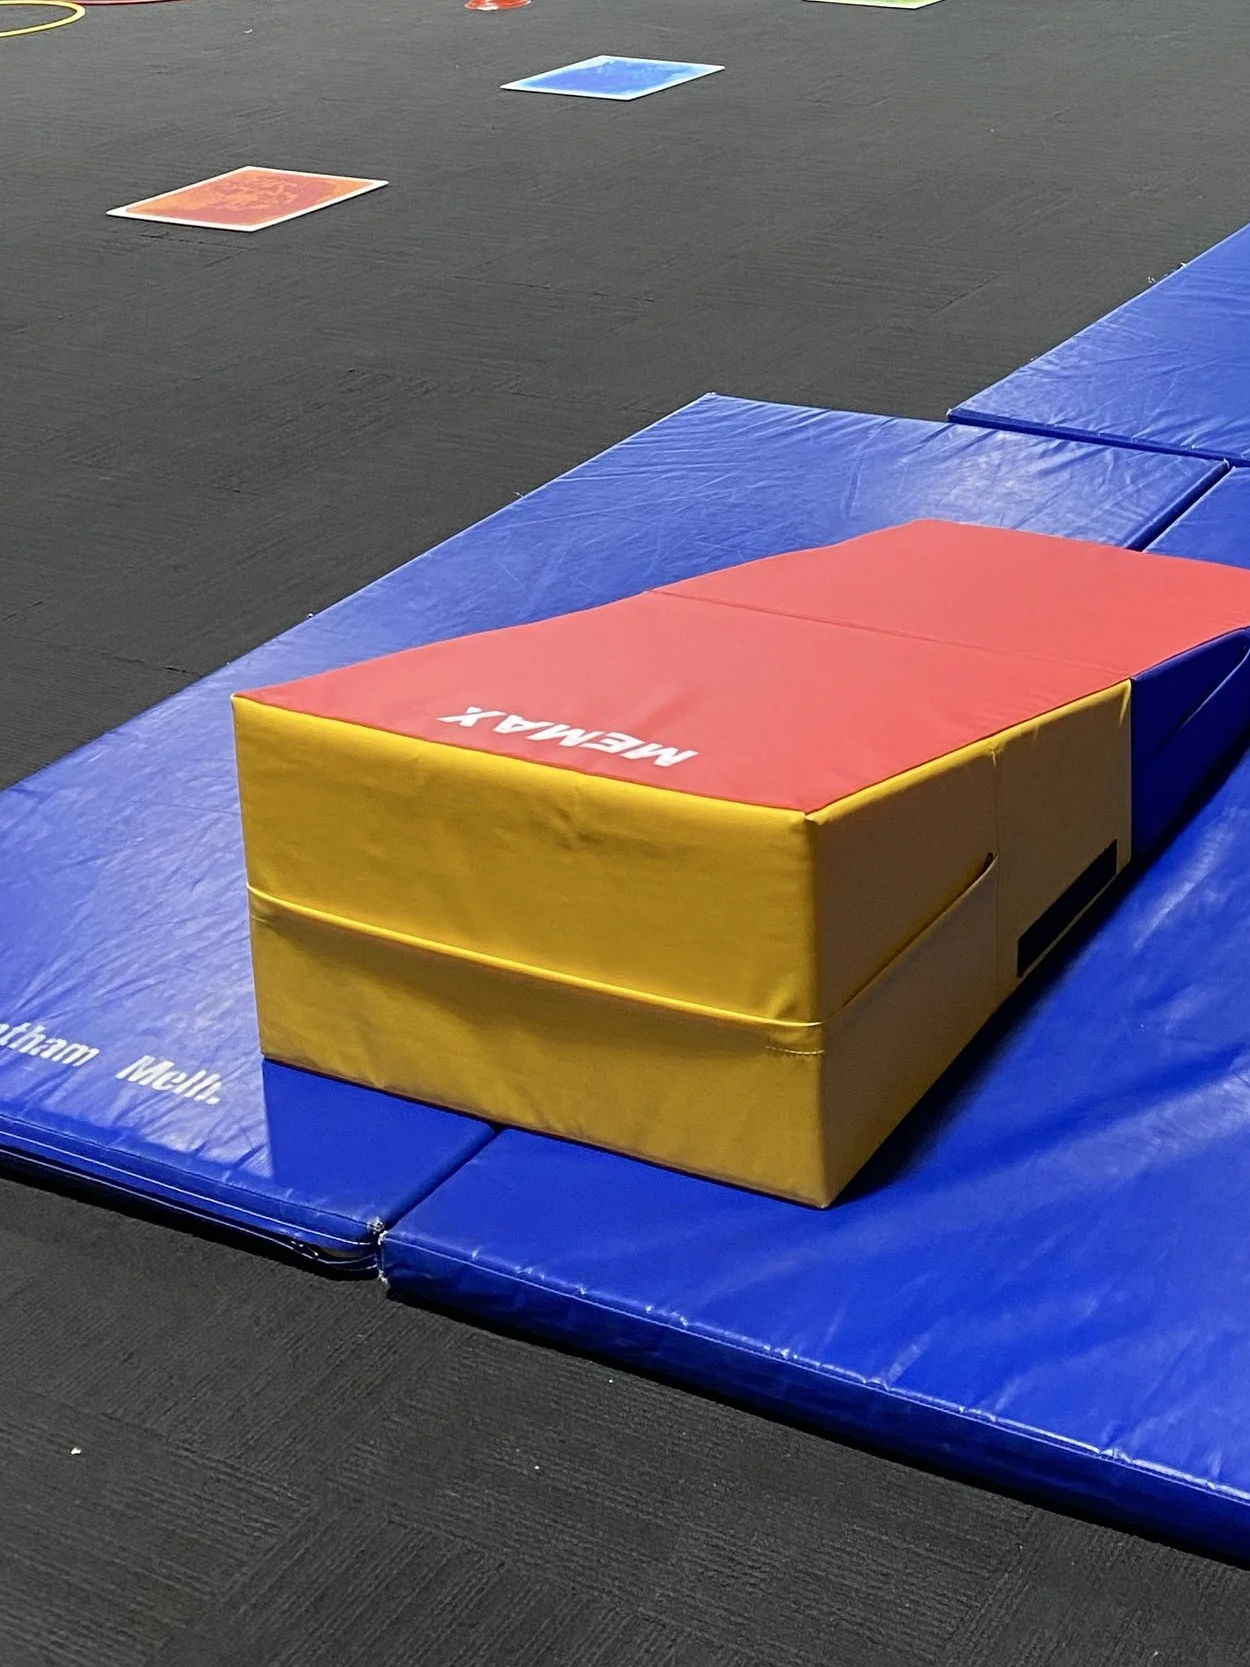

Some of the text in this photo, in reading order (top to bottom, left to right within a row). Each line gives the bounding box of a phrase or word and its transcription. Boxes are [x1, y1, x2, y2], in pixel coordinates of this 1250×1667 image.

[436, 706, 699, 767] MEMAX
[0, 1022, 222, 1105] tham Melb.
